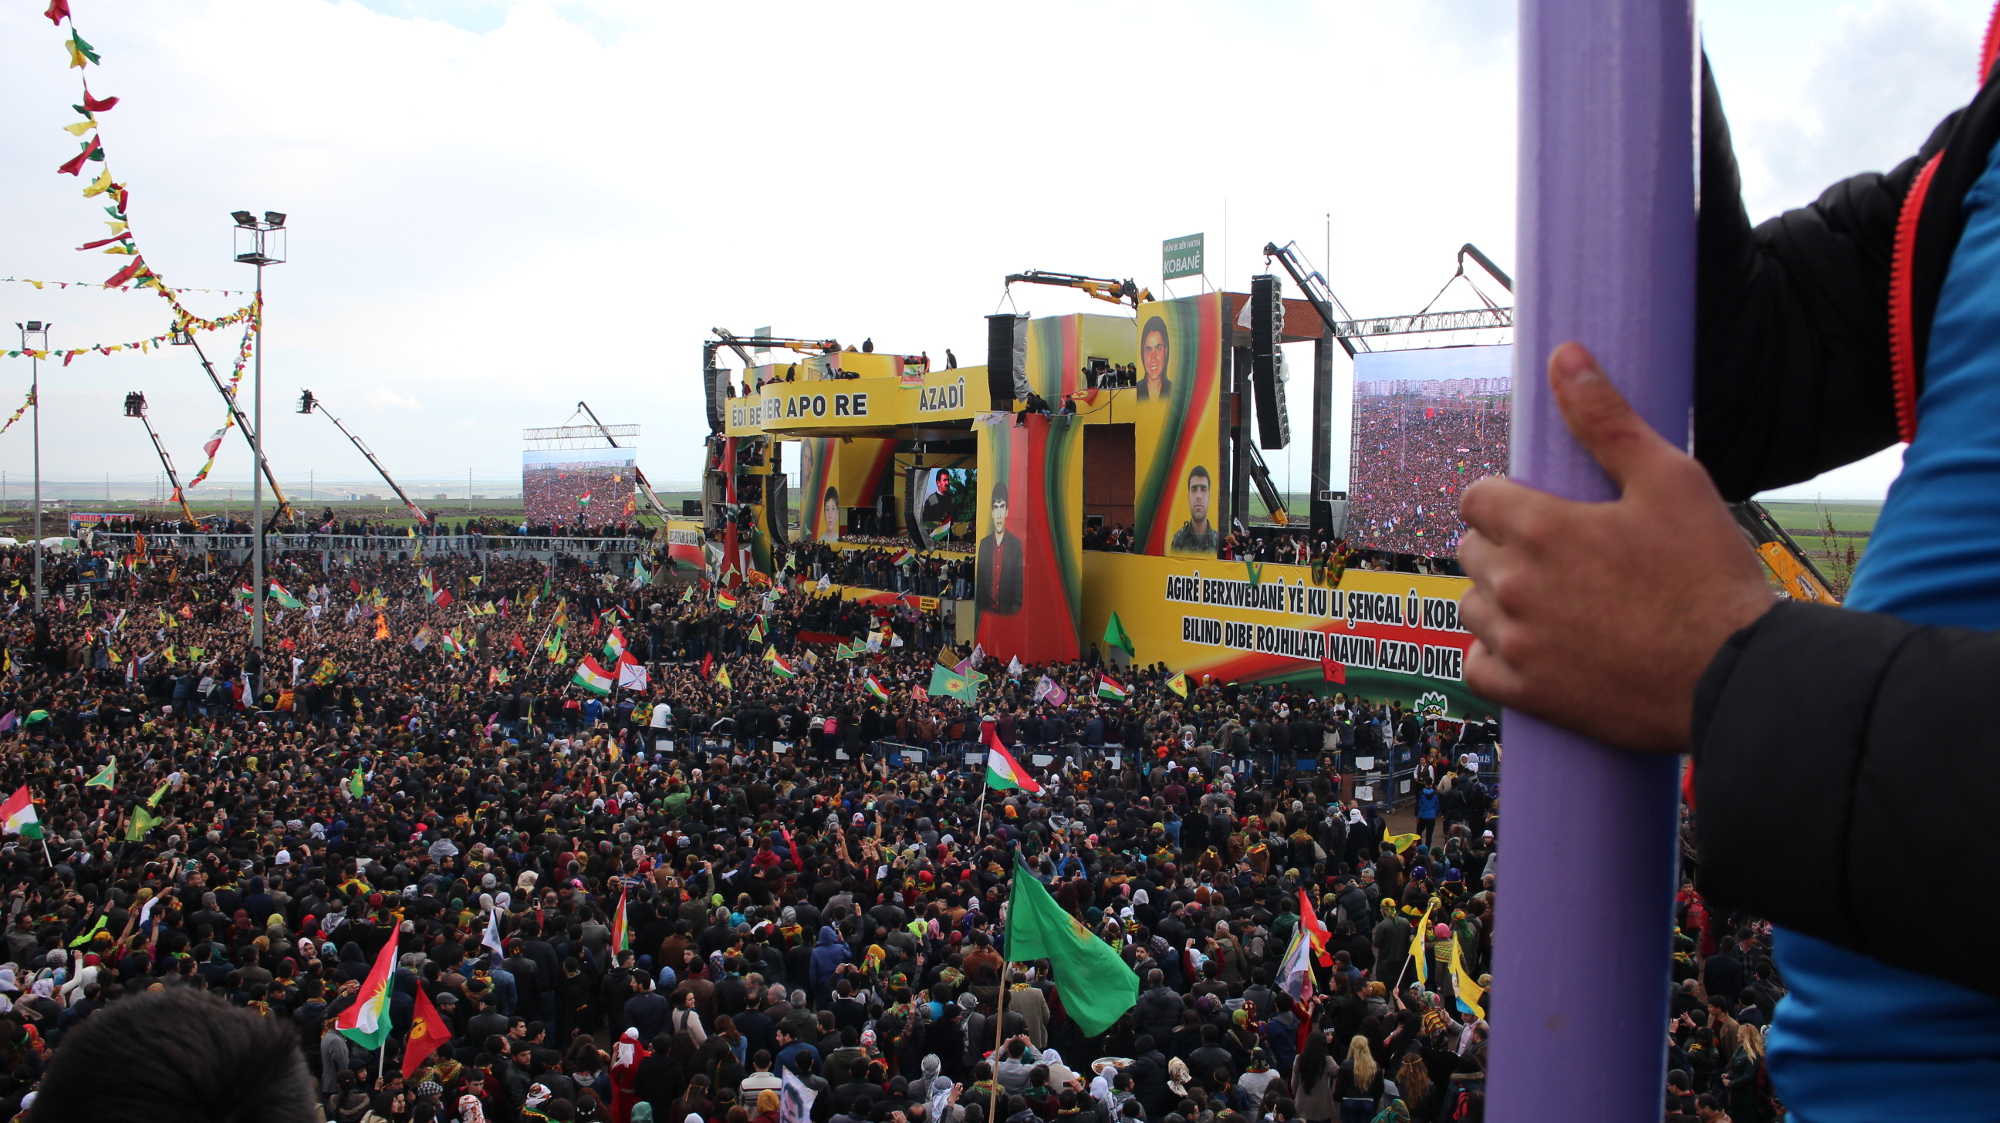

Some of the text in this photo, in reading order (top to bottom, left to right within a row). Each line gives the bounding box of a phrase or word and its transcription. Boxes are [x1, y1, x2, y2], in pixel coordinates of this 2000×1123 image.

[1164, 251, 1200, 274] KOBANÊ
[732, 405, 747, 427] ÊDÎ
[786, 394, 825, 418] APO
[835, 394, 867, 416] RE
[919, 377, 964, 412] AZADÎ
[1166, 571, 1200, 602] AGIRÊ
[1202, 578, 1284, 611] BERXWEDANÊ
[1288, 580, 1304, 613] YÊ
[1308, 588, 1327, 616] KU
[1331, 591, 1343, 618] LI
[1347, 592, 1402, 627] ŞENGAL
[1407, 590, 1418, 626] Û
[1183, 617, 1462, 679] BILIND DIBE ROJHILATA NAVIN AZAD DIKE
